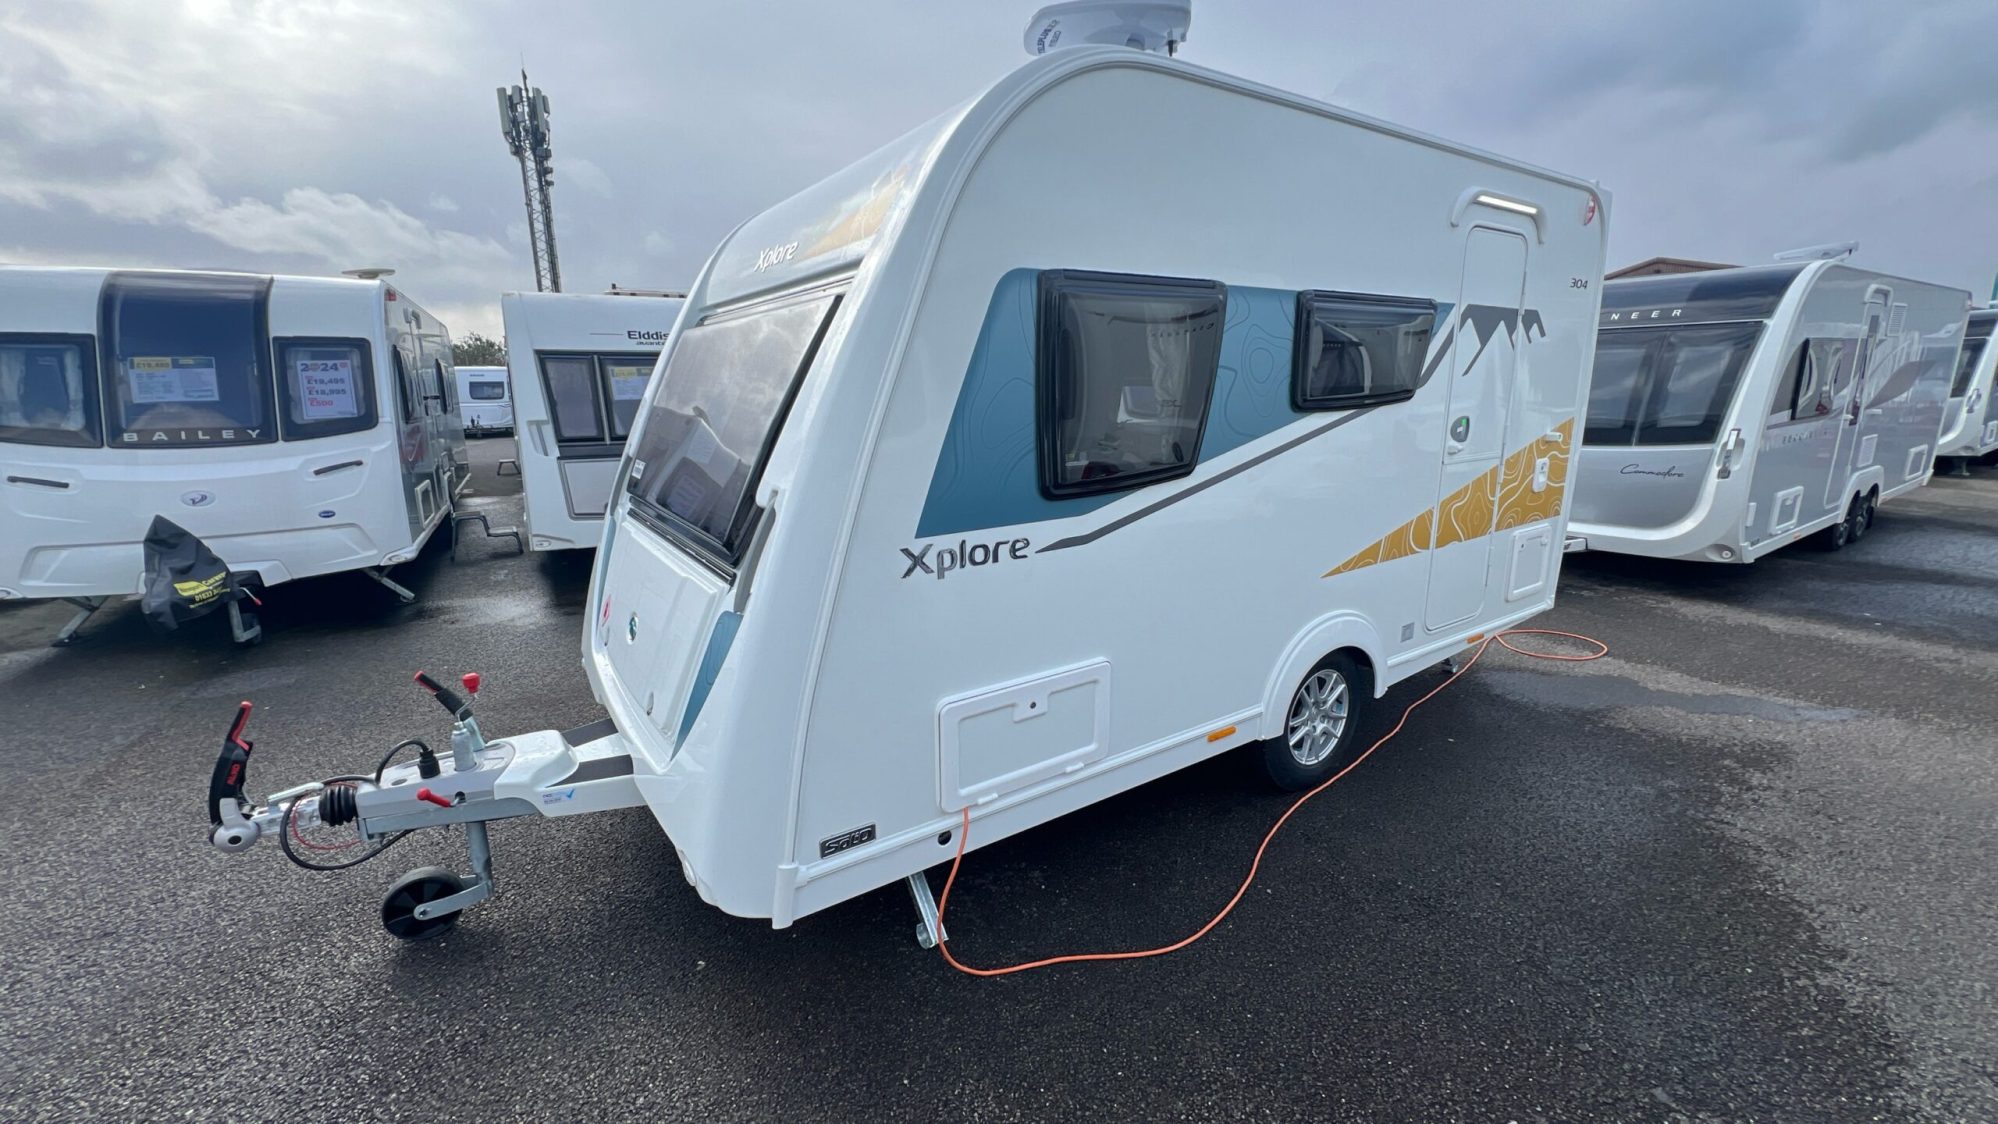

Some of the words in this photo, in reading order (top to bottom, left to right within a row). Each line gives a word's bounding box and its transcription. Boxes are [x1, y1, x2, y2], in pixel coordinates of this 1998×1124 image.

[753, 241, 799, 272] Xplore
[1570, 278, 1588, 289] 304
[123, 429, 261, 442] BAILEY
[899, 537, 1031, 580] Xplore
